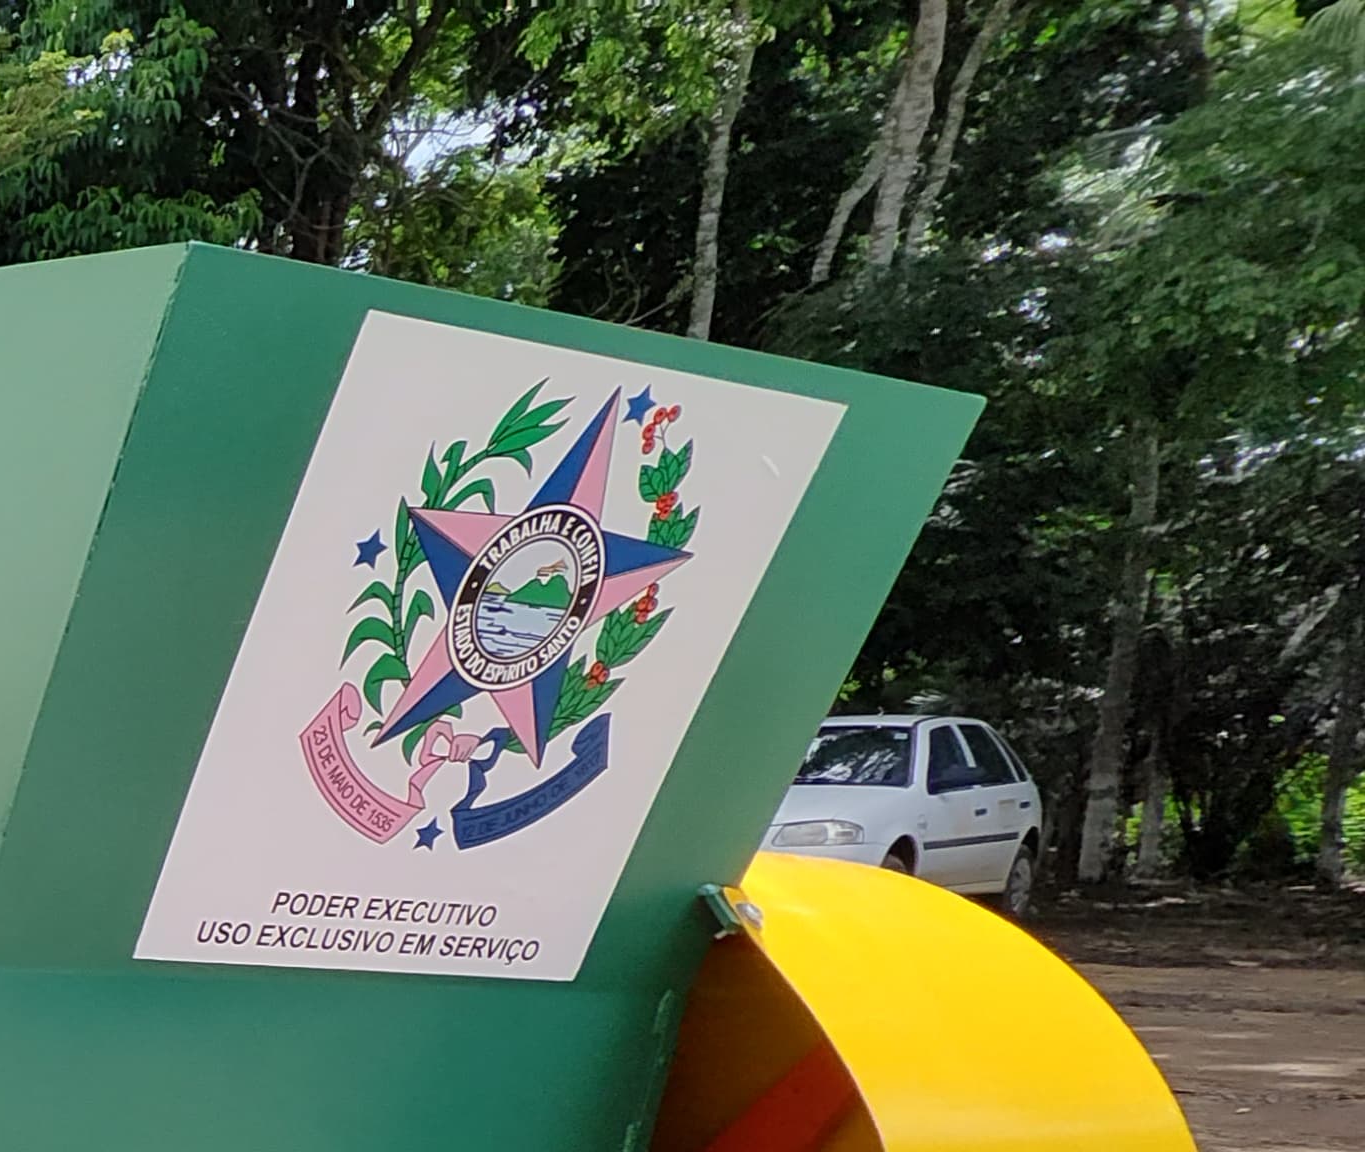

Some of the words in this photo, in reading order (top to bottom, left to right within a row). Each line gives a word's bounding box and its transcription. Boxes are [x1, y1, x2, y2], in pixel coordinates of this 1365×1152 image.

[480, 514, 563, 570] TRABALHA
[562, 517, 577, 536] E
[571, 524, 599, 587] CONFIA
[455, 603, 476, 660] ESTADO
[540, 616, 581, 665] SANTO
[465, 653, 485, 675] DO
[313, 725, 329, 746] 23
[319, 745, 336, 769] DE
[328, 766, 355, 800] MAIO
[350, 794, 371, 817] DE
[367, 809, 396, 833] 1535
[271, 891, 360, 919] PODER
[362, 897, 498, 928] EXECUTIVO
[196, 920, 252, 946] USO
[255, 925, 395, 954] EXCLUSIVO
[397, 932, 437, 956] EM
[439, 935, 541, 966] SERVIÇO
